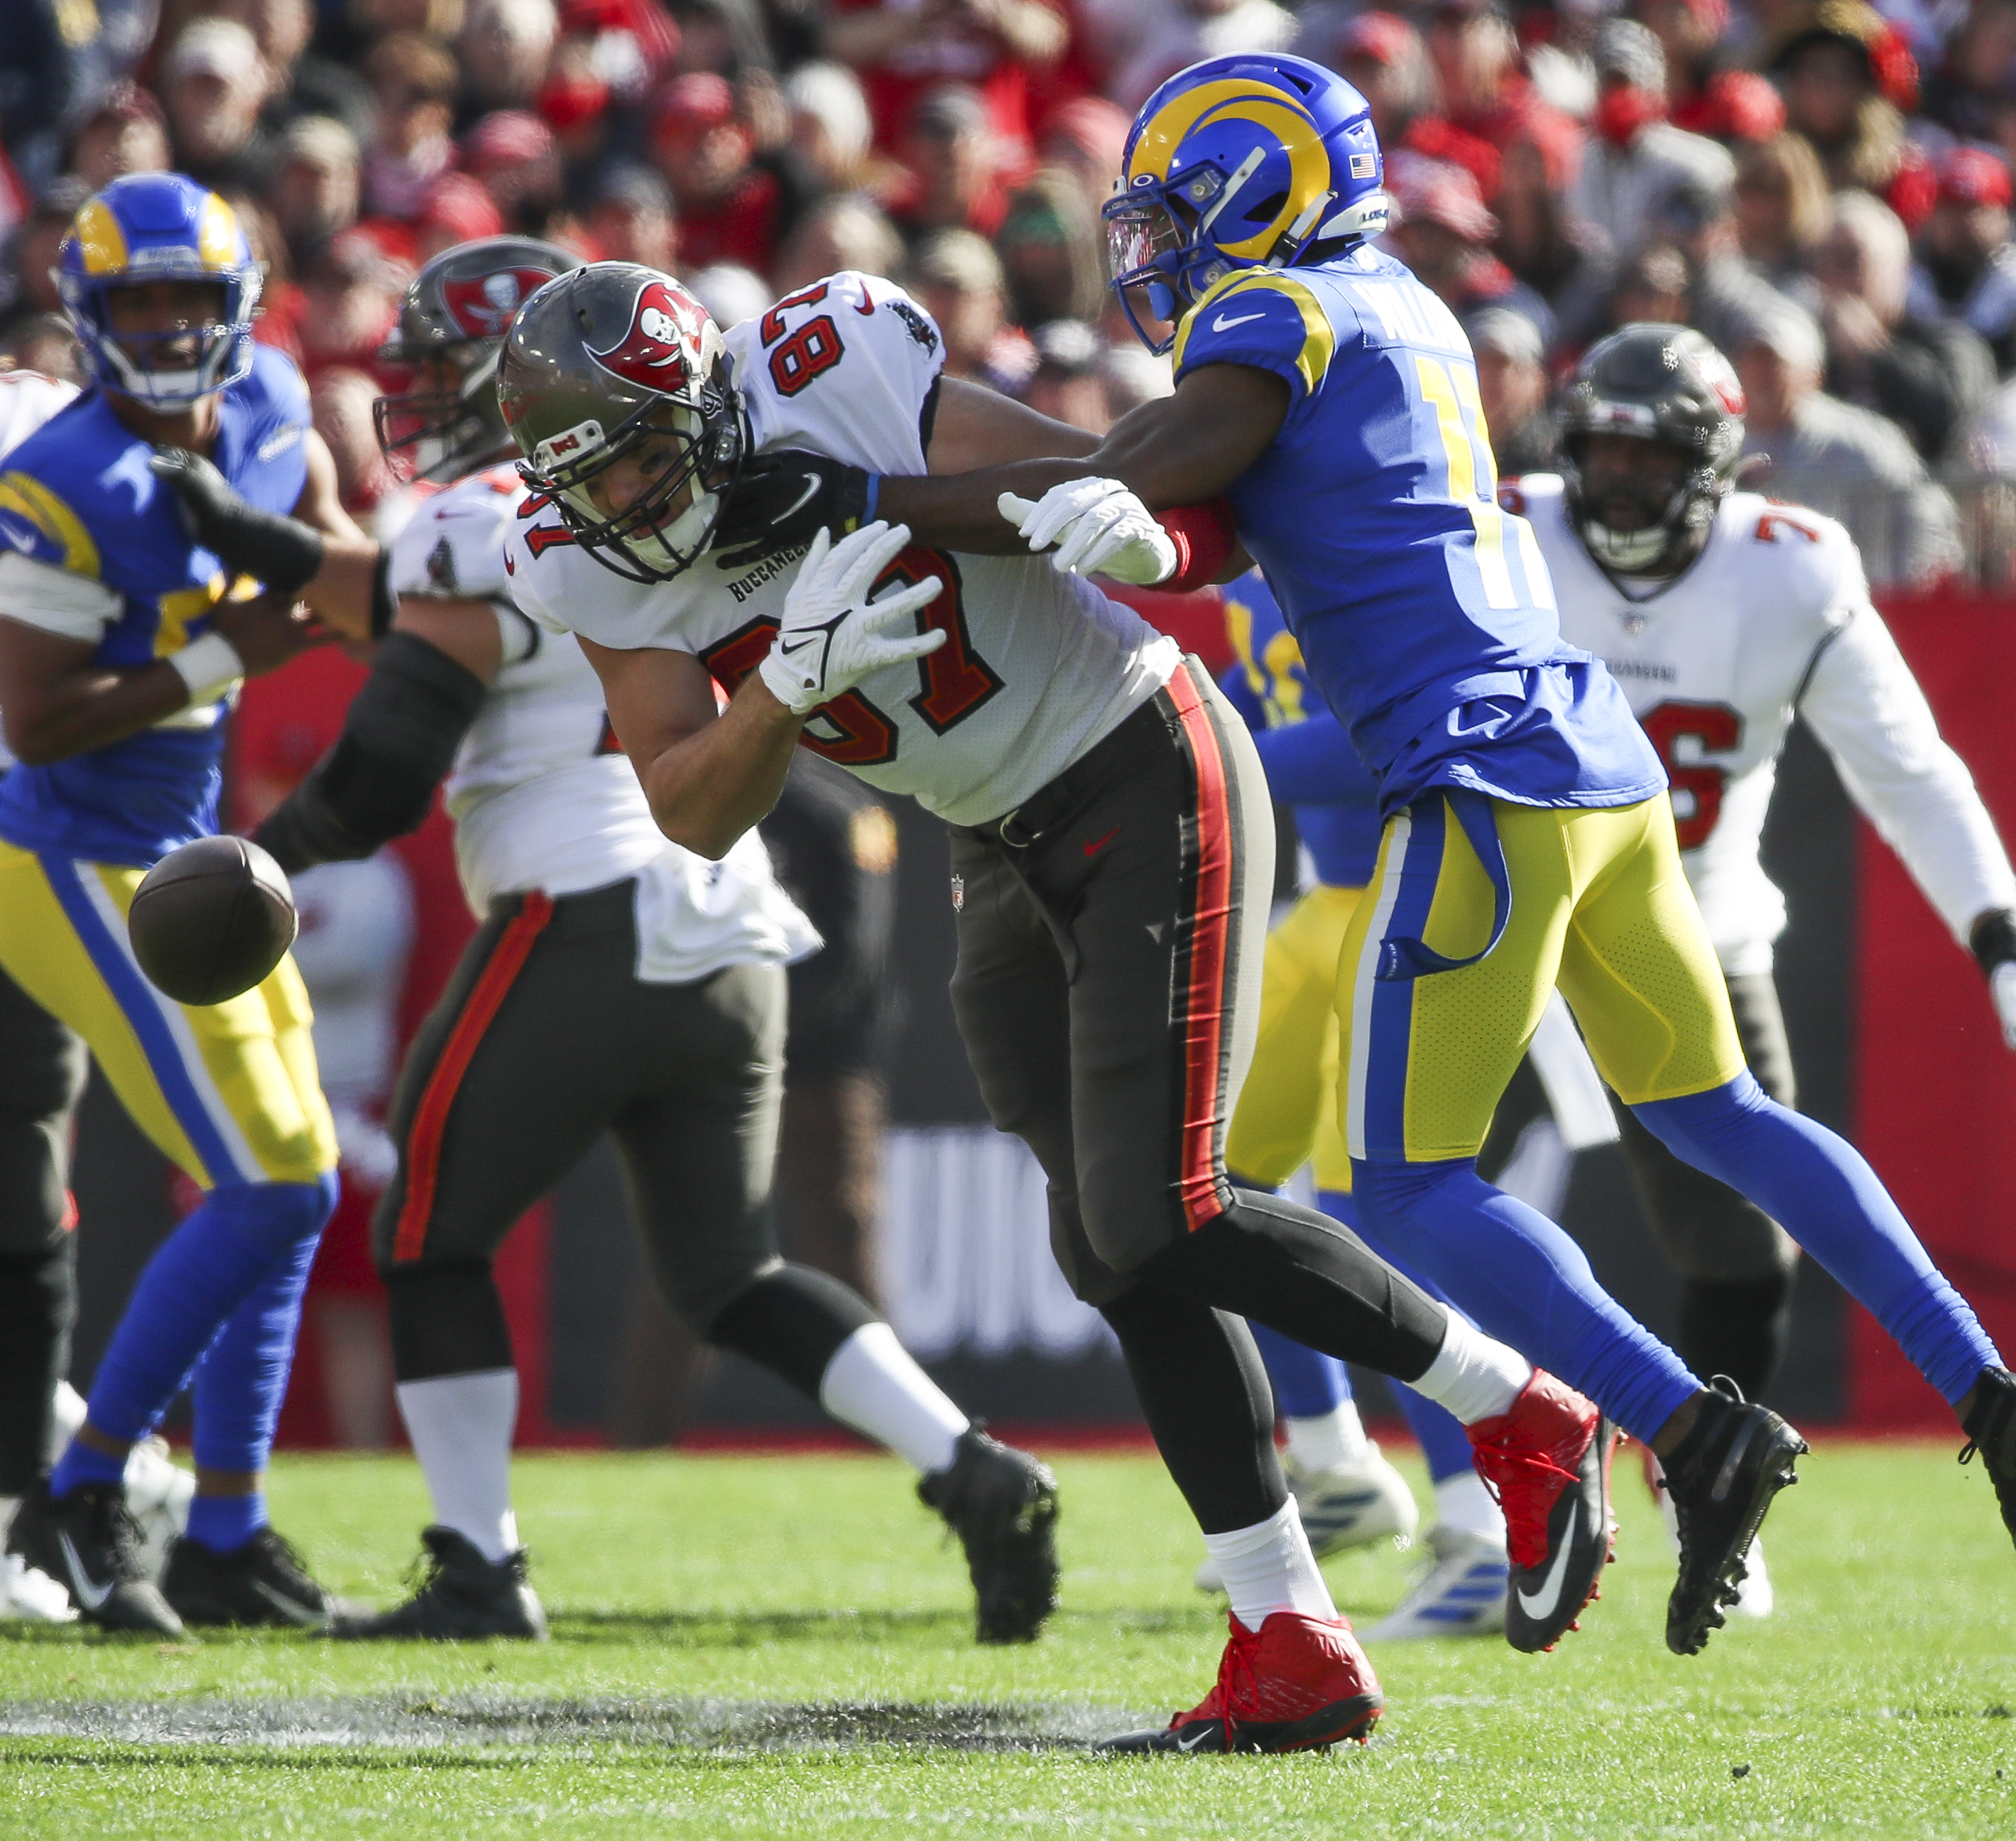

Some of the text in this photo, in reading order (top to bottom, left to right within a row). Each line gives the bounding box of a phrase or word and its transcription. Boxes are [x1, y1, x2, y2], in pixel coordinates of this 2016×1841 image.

[760, 282, 846, 398] 87
[1350, 283, 1473, 355] WILLIA
[1414, 355, 1555, 610] 11
[726, 543, 813, 604] BUCCANEE
